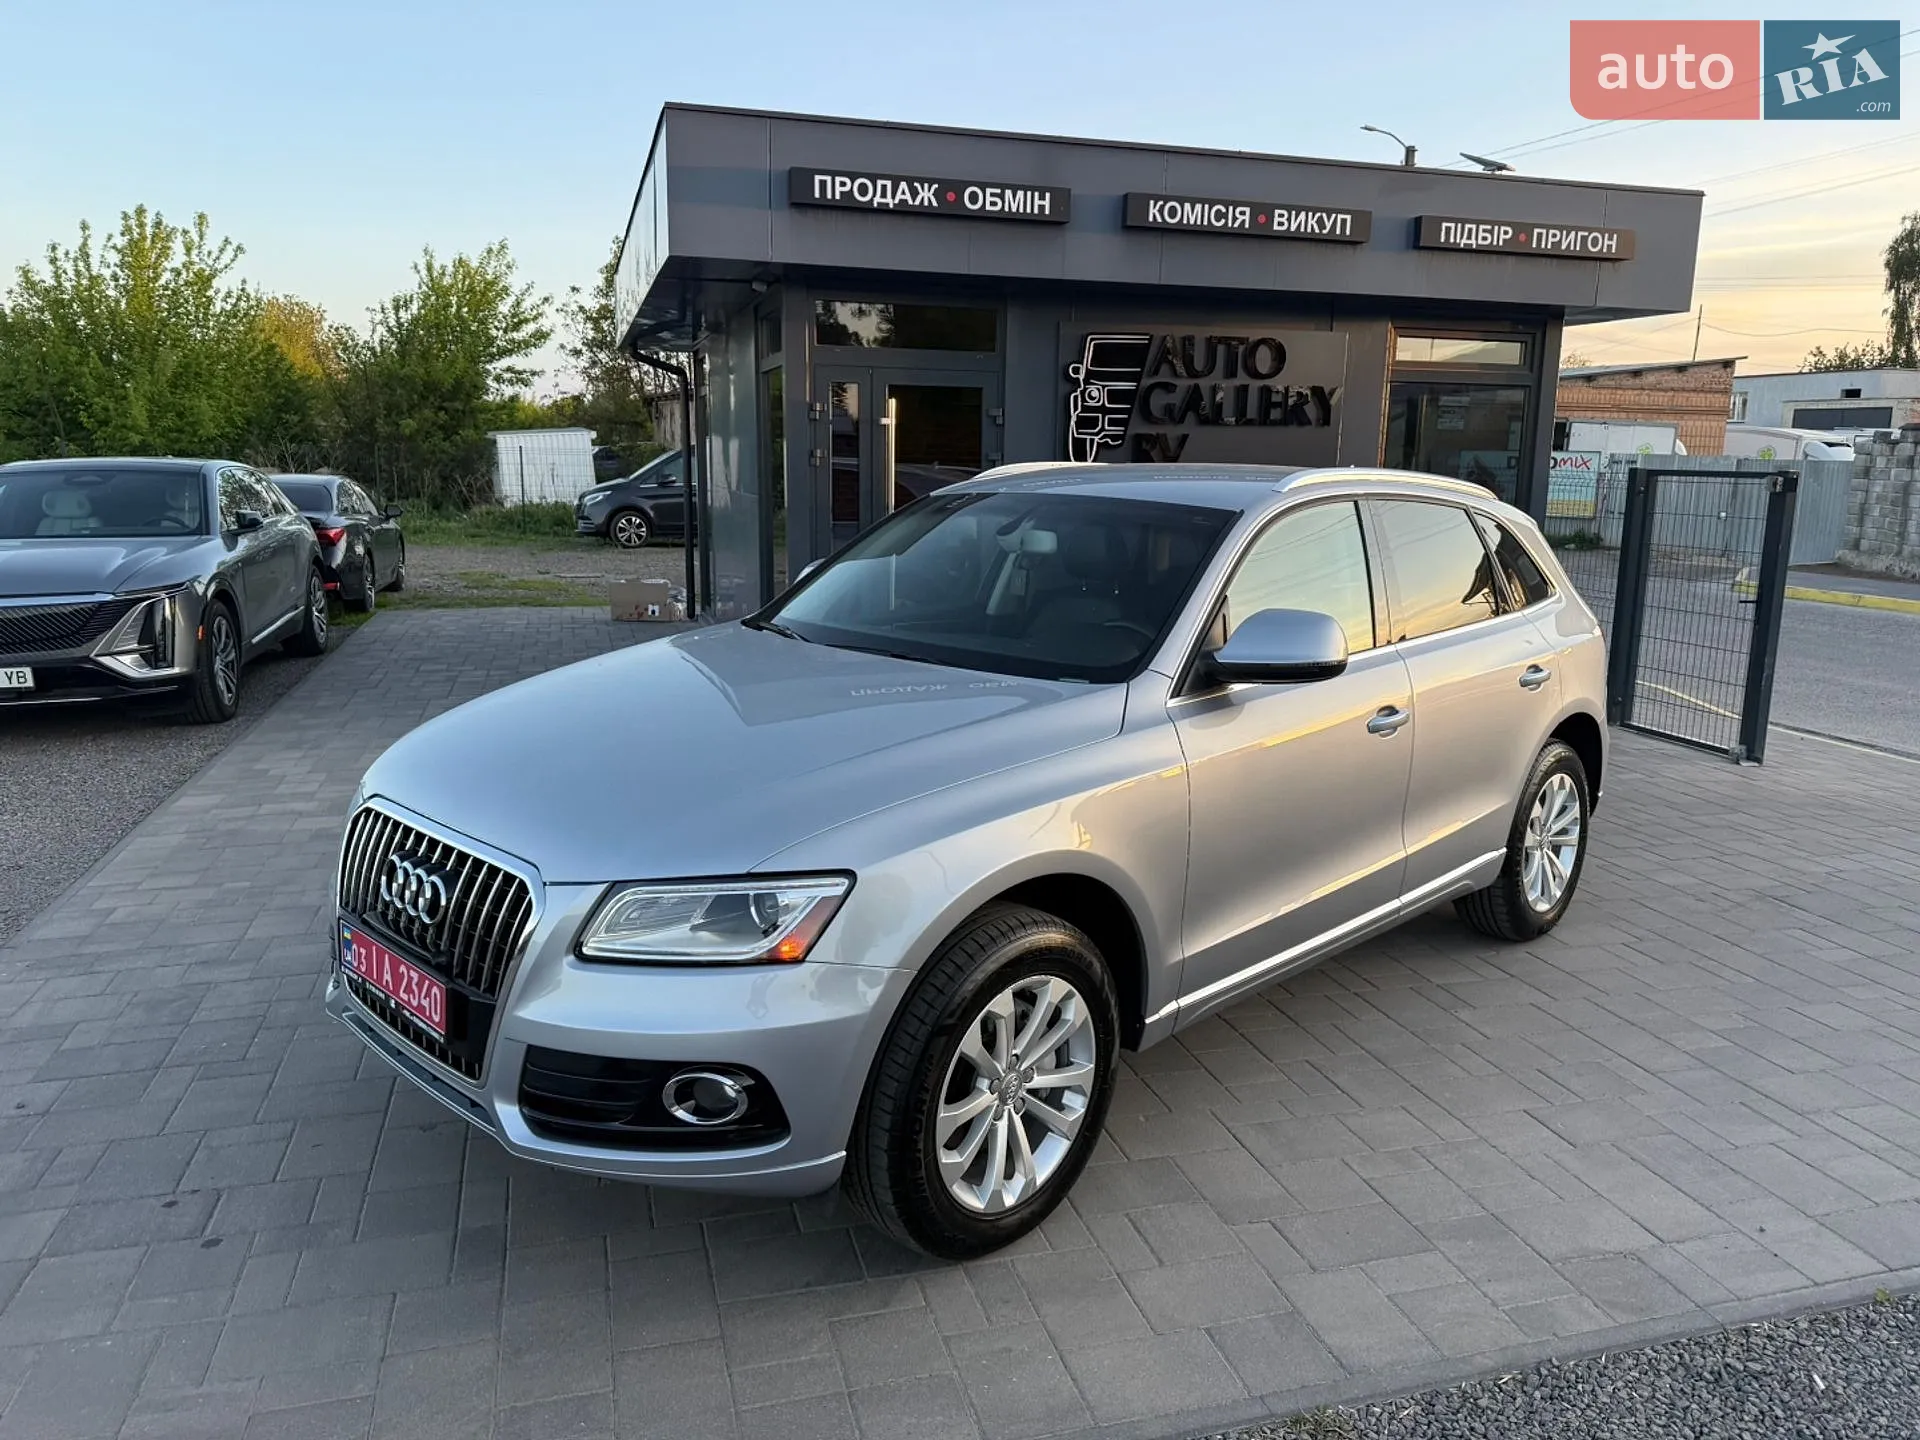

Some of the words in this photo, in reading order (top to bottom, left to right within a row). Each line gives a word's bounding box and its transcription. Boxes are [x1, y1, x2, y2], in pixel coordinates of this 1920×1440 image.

[814, 174, 939, 209] ПРОДАЖ
[963, 186, 1051, 215] ОБМІН
[1148, 199, 1251, 229] КОМІСІЯ
[1272, 209, 1352, 236] ВИКУП
[1440, 221, 1514, 248] ПІДБІР
[1531, 227, 1618, 254] ПРИГОН
[1150, 334, 1287, 380] AUTO
[1138, 381, 1344, 427] GALLERY
